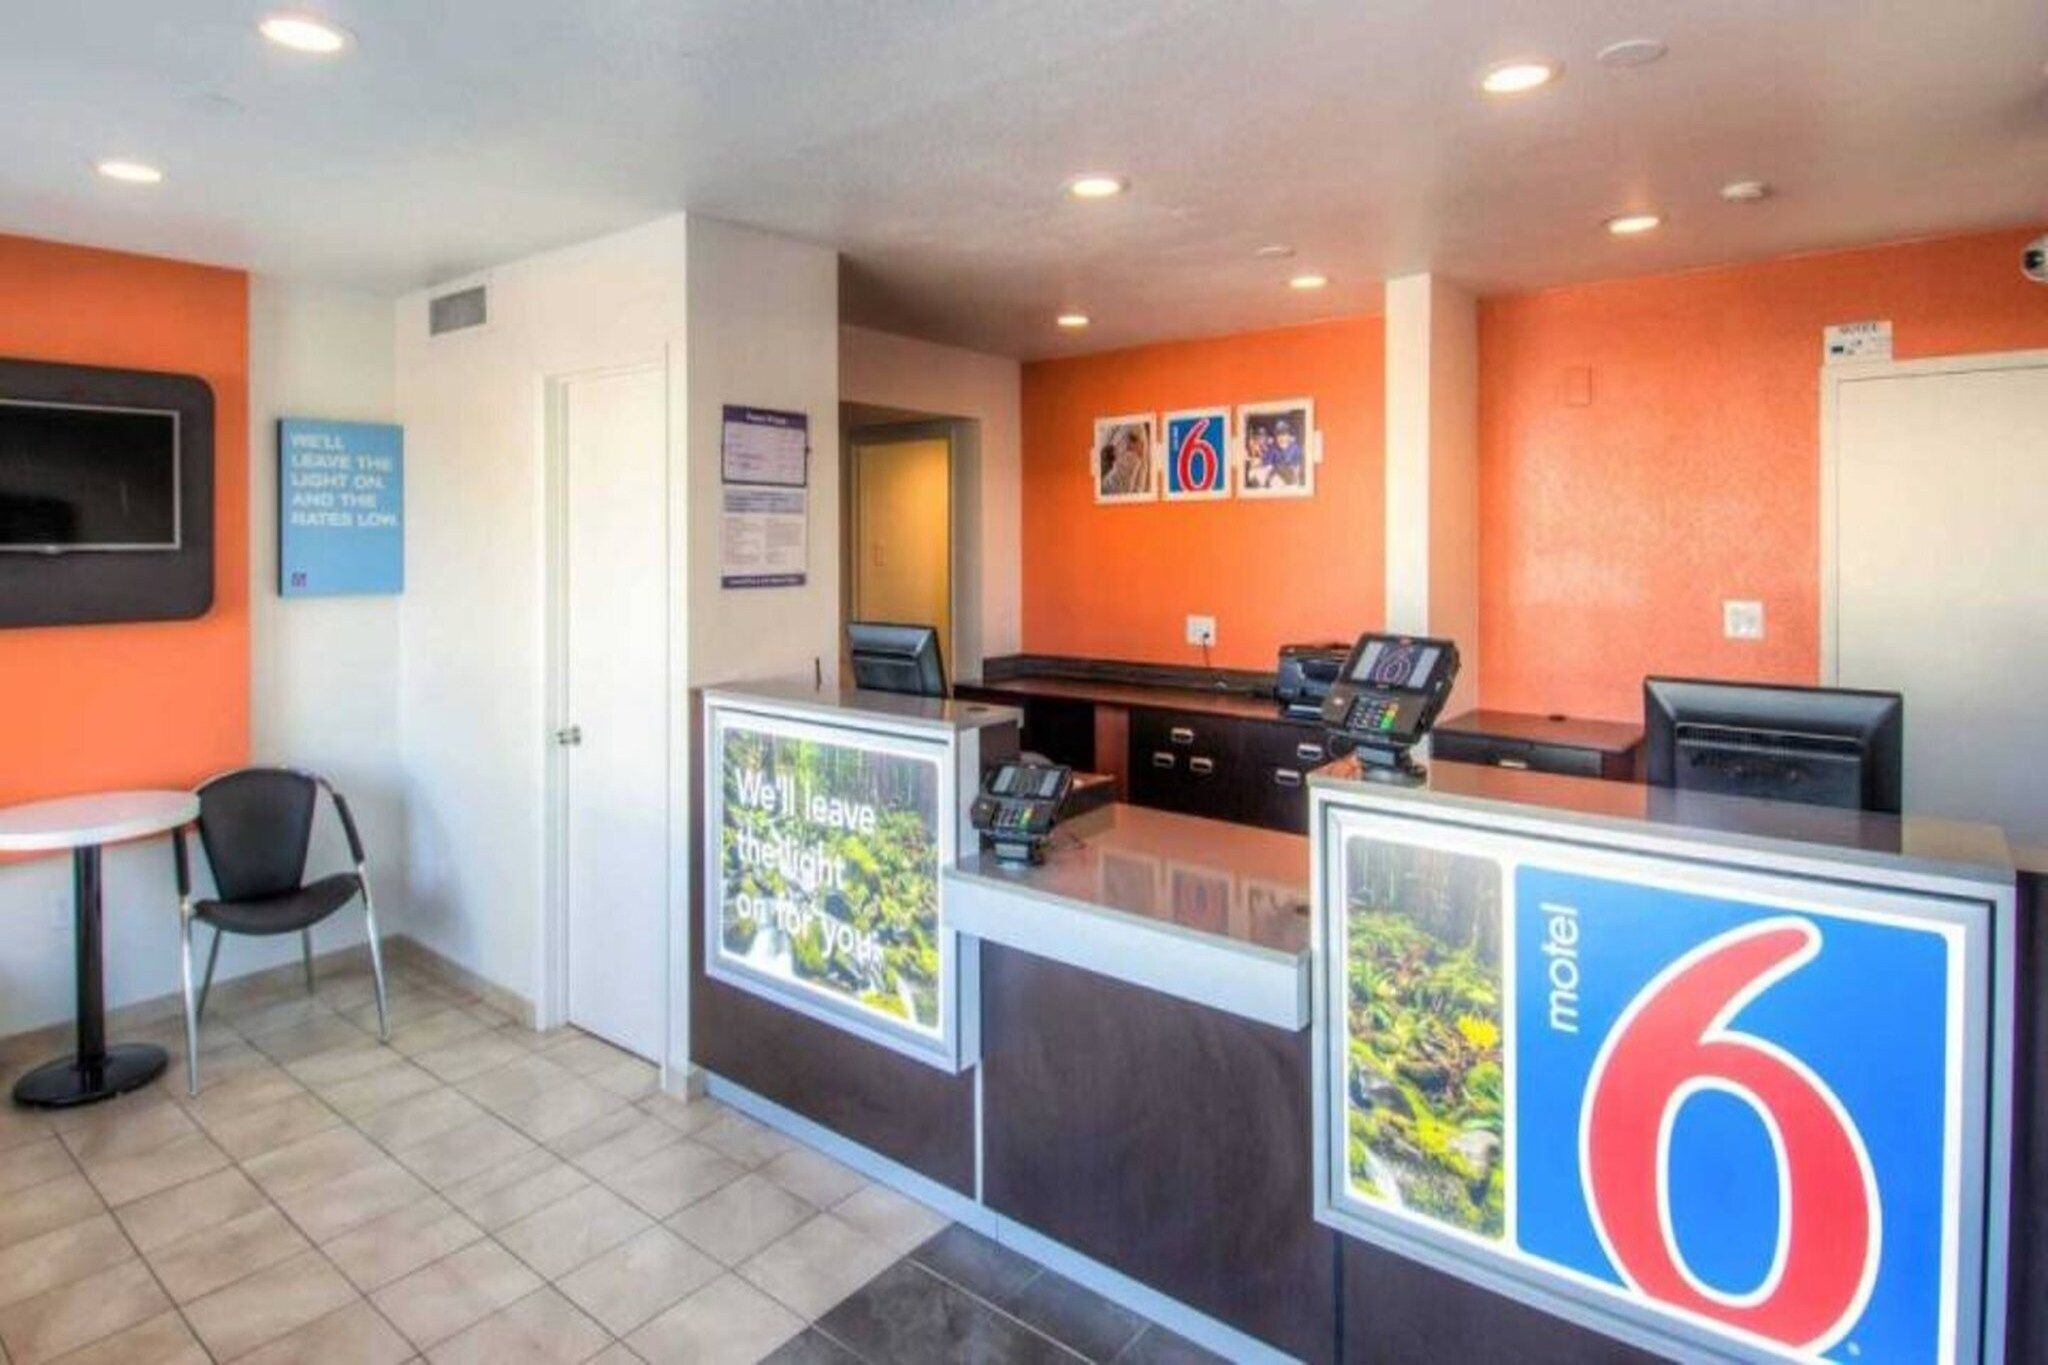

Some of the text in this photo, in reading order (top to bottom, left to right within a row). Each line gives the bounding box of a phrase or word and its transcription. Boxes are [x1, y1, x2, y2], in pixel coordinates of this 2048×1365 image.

[291, 473, 347, 488] LIGHT
[292, 453, 393, 473] LEAVE THE
[1177, 418, 1218, 492] 6
[290, 511, 353, 527] RATES
[292, 492, 377, 510] AND THE
[734, 767, 876, 835] We'll leave
[737, 826, 845, 894] the light
[737, 893, 767, 924] on
[777, 890, 815, 940] for
[1538, 902, 1580, 1034] motel
[1579, 915, 1882, 1356] 6
